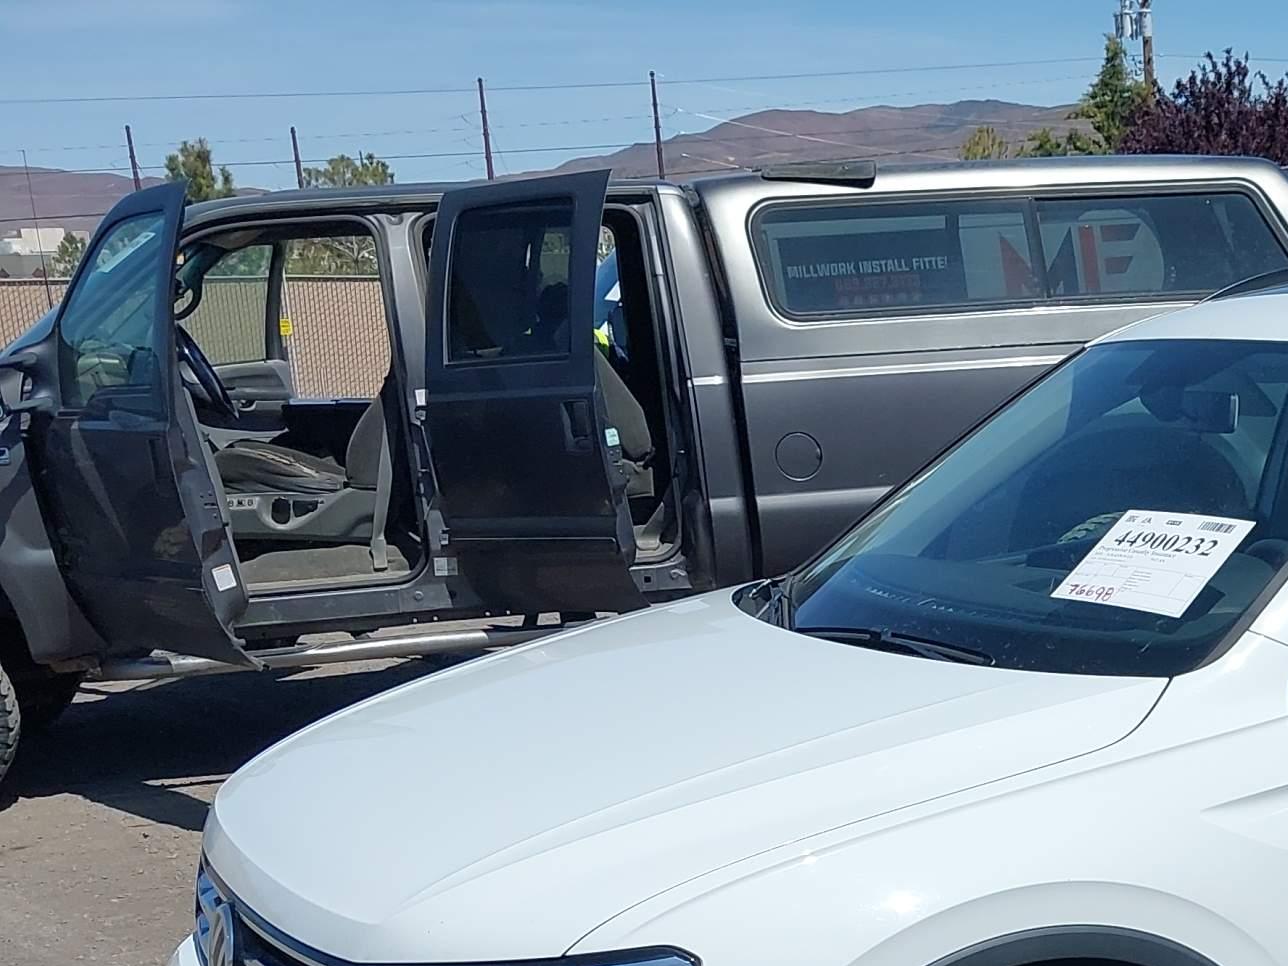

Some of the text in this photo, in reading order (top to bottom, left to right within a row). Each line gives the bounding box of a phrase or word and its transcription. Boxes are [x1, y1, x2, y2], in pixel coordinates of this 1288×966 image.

[787, 263, 856, 279] MILLWORK
[859, 258, 909, 273] INSTALL
[1114, 530, 1218, 557] 44900232
